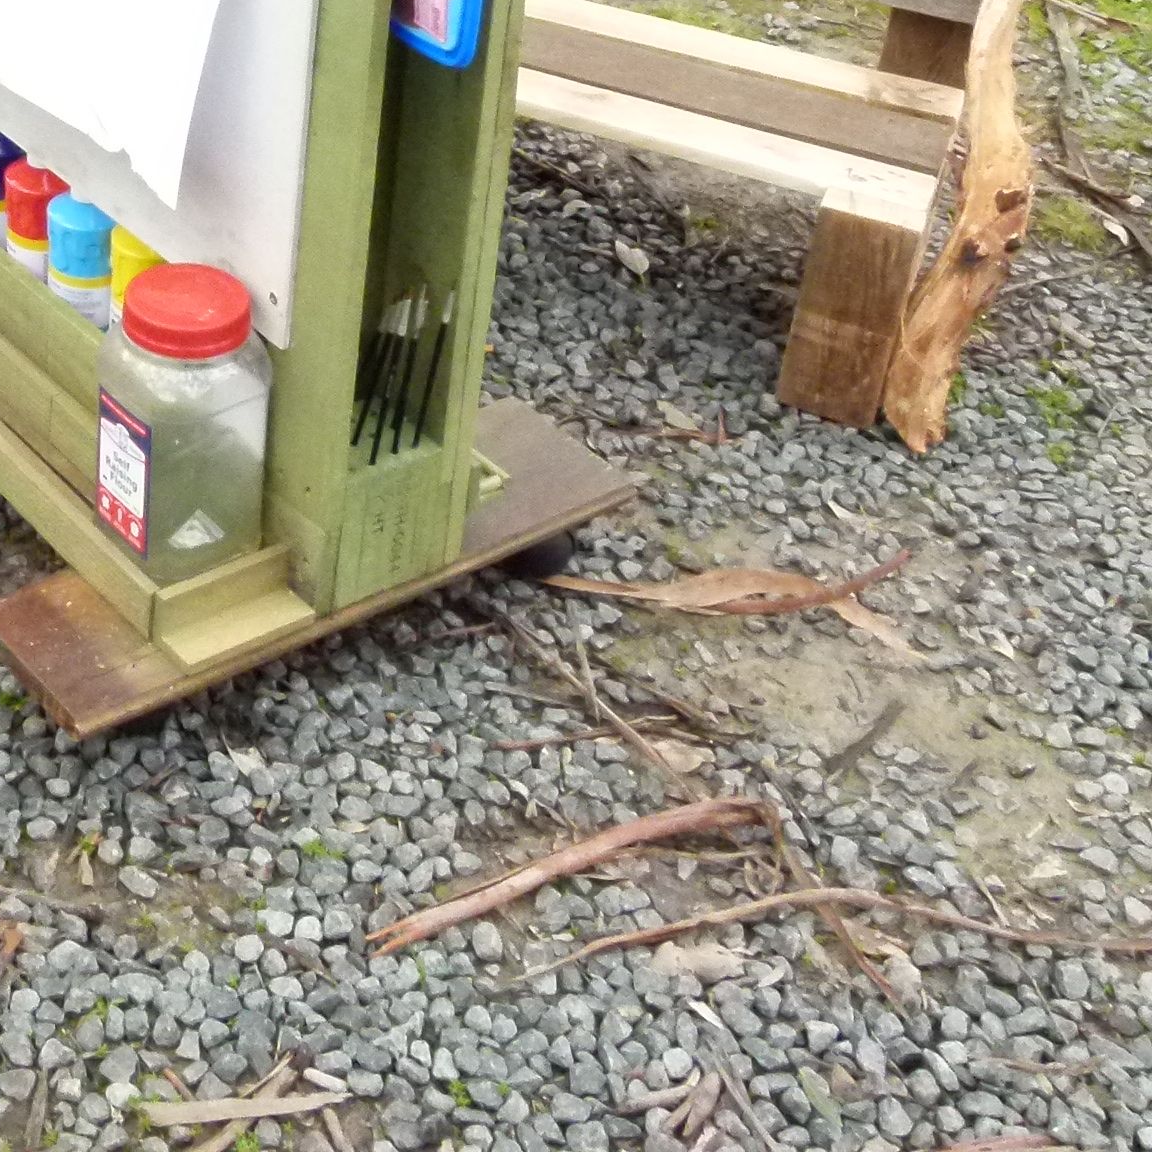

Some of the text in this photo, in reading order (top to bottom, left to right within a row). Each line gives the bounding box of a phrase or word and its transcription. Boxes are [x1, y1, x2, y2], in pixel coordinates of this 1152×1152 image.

[105, 455, 137, 493] Raising
[113, 451, 130, 472] Self
[109, 470, 132, 496] Flour
